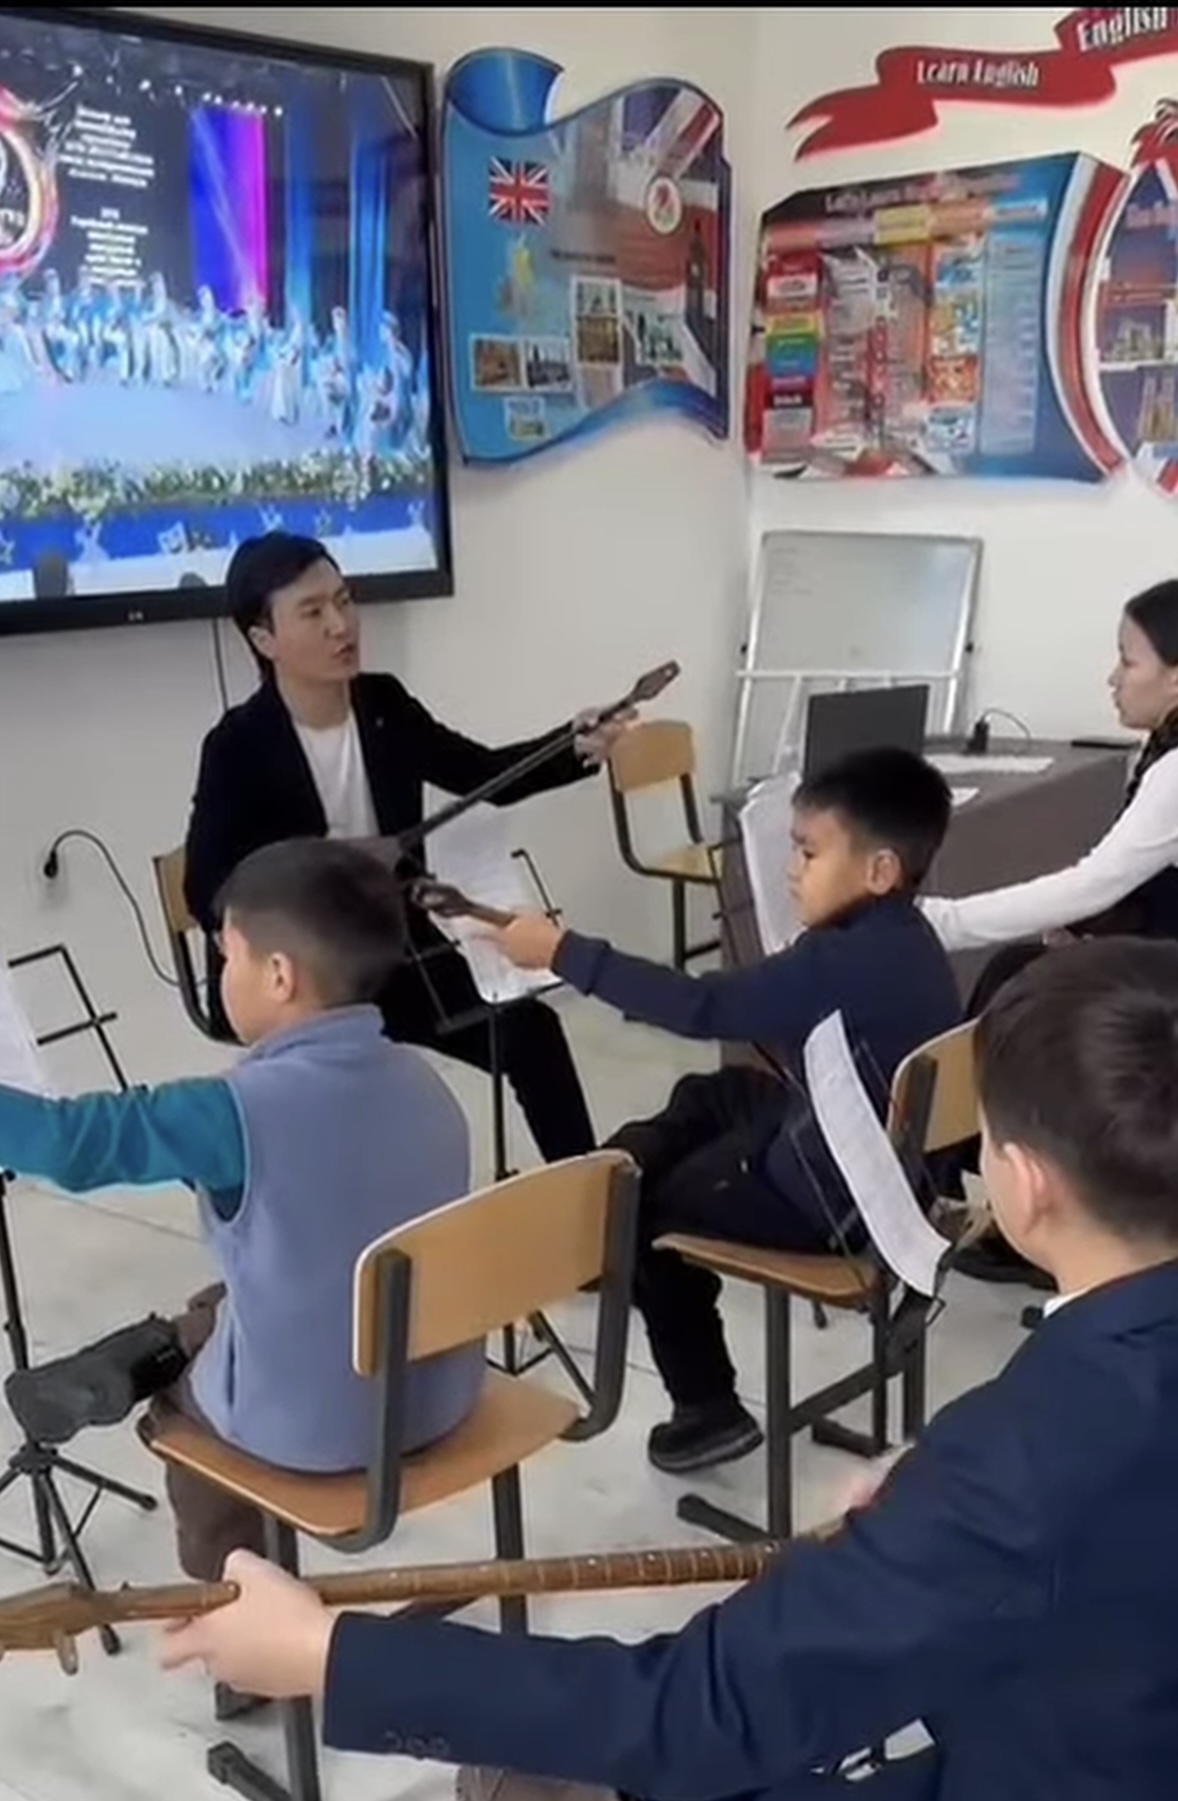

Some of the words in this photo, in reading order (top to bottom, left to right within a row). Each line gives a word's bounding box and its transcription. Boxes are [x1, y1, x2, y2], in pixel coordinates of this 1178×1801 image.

[1076, 8, 1168, 52] English
[916, 60, 969, 85] Learn
[972, 59, 1039, 88] English
